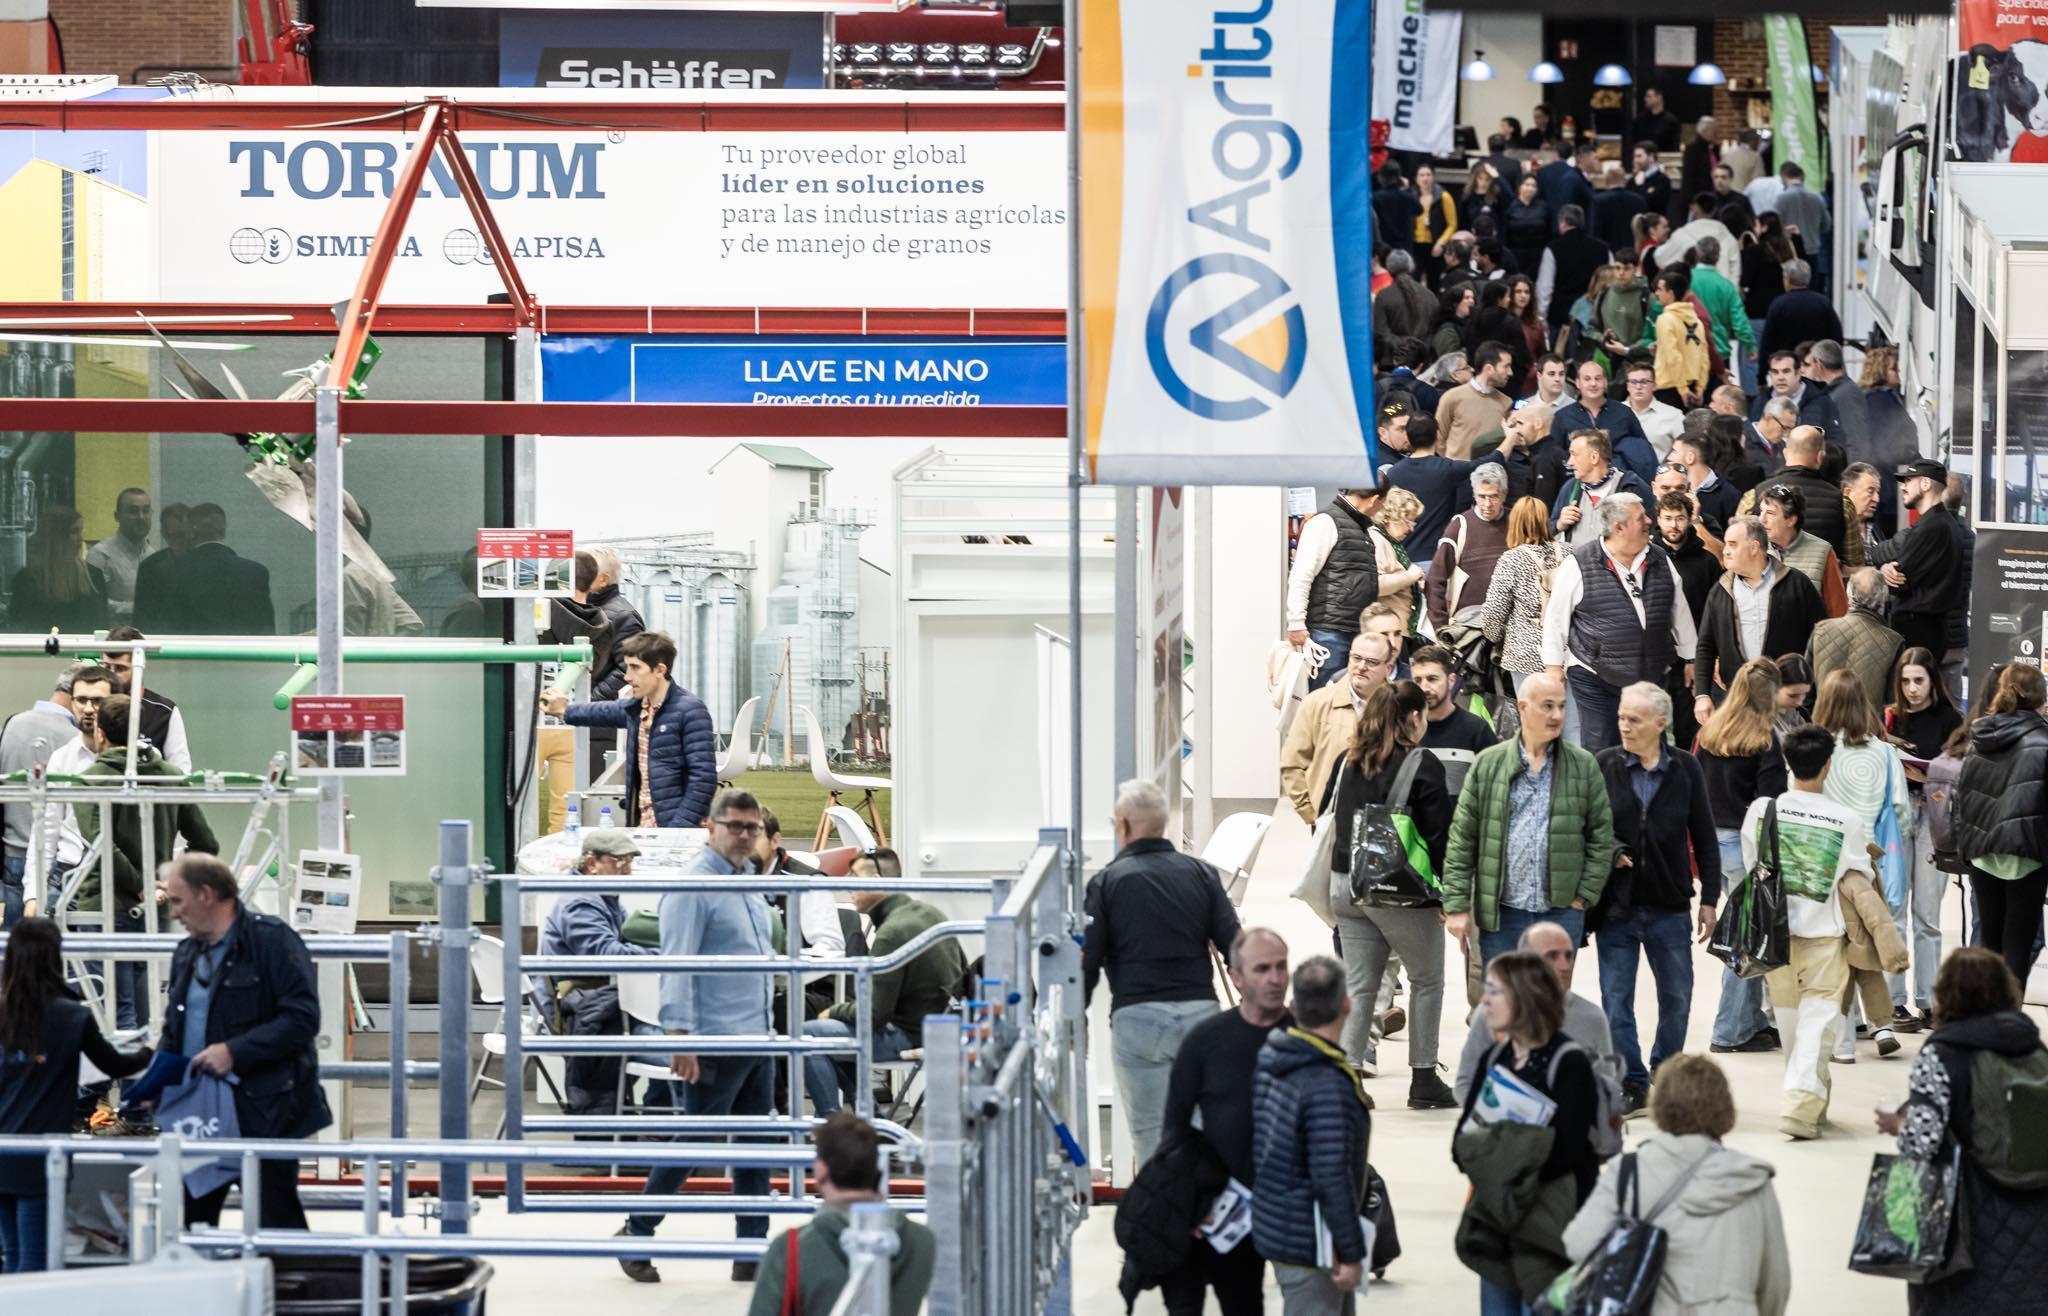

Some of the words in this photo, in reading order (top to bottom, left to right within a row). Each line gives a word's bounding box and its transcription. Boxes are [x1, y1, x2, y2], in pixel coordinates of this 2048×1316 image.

[1995, 14, 2030, 28] pour
[2032, 15, 2048, 27] ve
[546, 60, 776, 89] Schäffer
[722, 145, 752, 164] Tu
[760, 145, 887, 170] proveedor
[893, 144, 967, 170] global
[229, 140, 606, 200] TORNUM
[721, 174, 789, 193] líder
[796, 179, 828, 193] en
[836, 174, 985, 194] soluciones
[722, 208, 777, 228] para
[783, 204, 818, 223] las
[824, 204, 948, 224] industrias
[955, 204, 1066, 230] agrícolas
[513, 237, 606, 258] APISA
[721, 238, 735, 259] y
[741, 233, 769, 253] de
[776, 234, 866, 259] manejo
[872, 234, 900, 253] de
[908, 238, 991, 259] granos
[744, 360, 836, 383] LLAVE
[845, 360, 885, 382] EN
[895, 359, 989, 382] MANO
[855, 393, 868, 406] a
[874, 391, 896, 406] tu
[902, 391, 980, 407] medida
[1809, 813, 1844, 826] MONET
